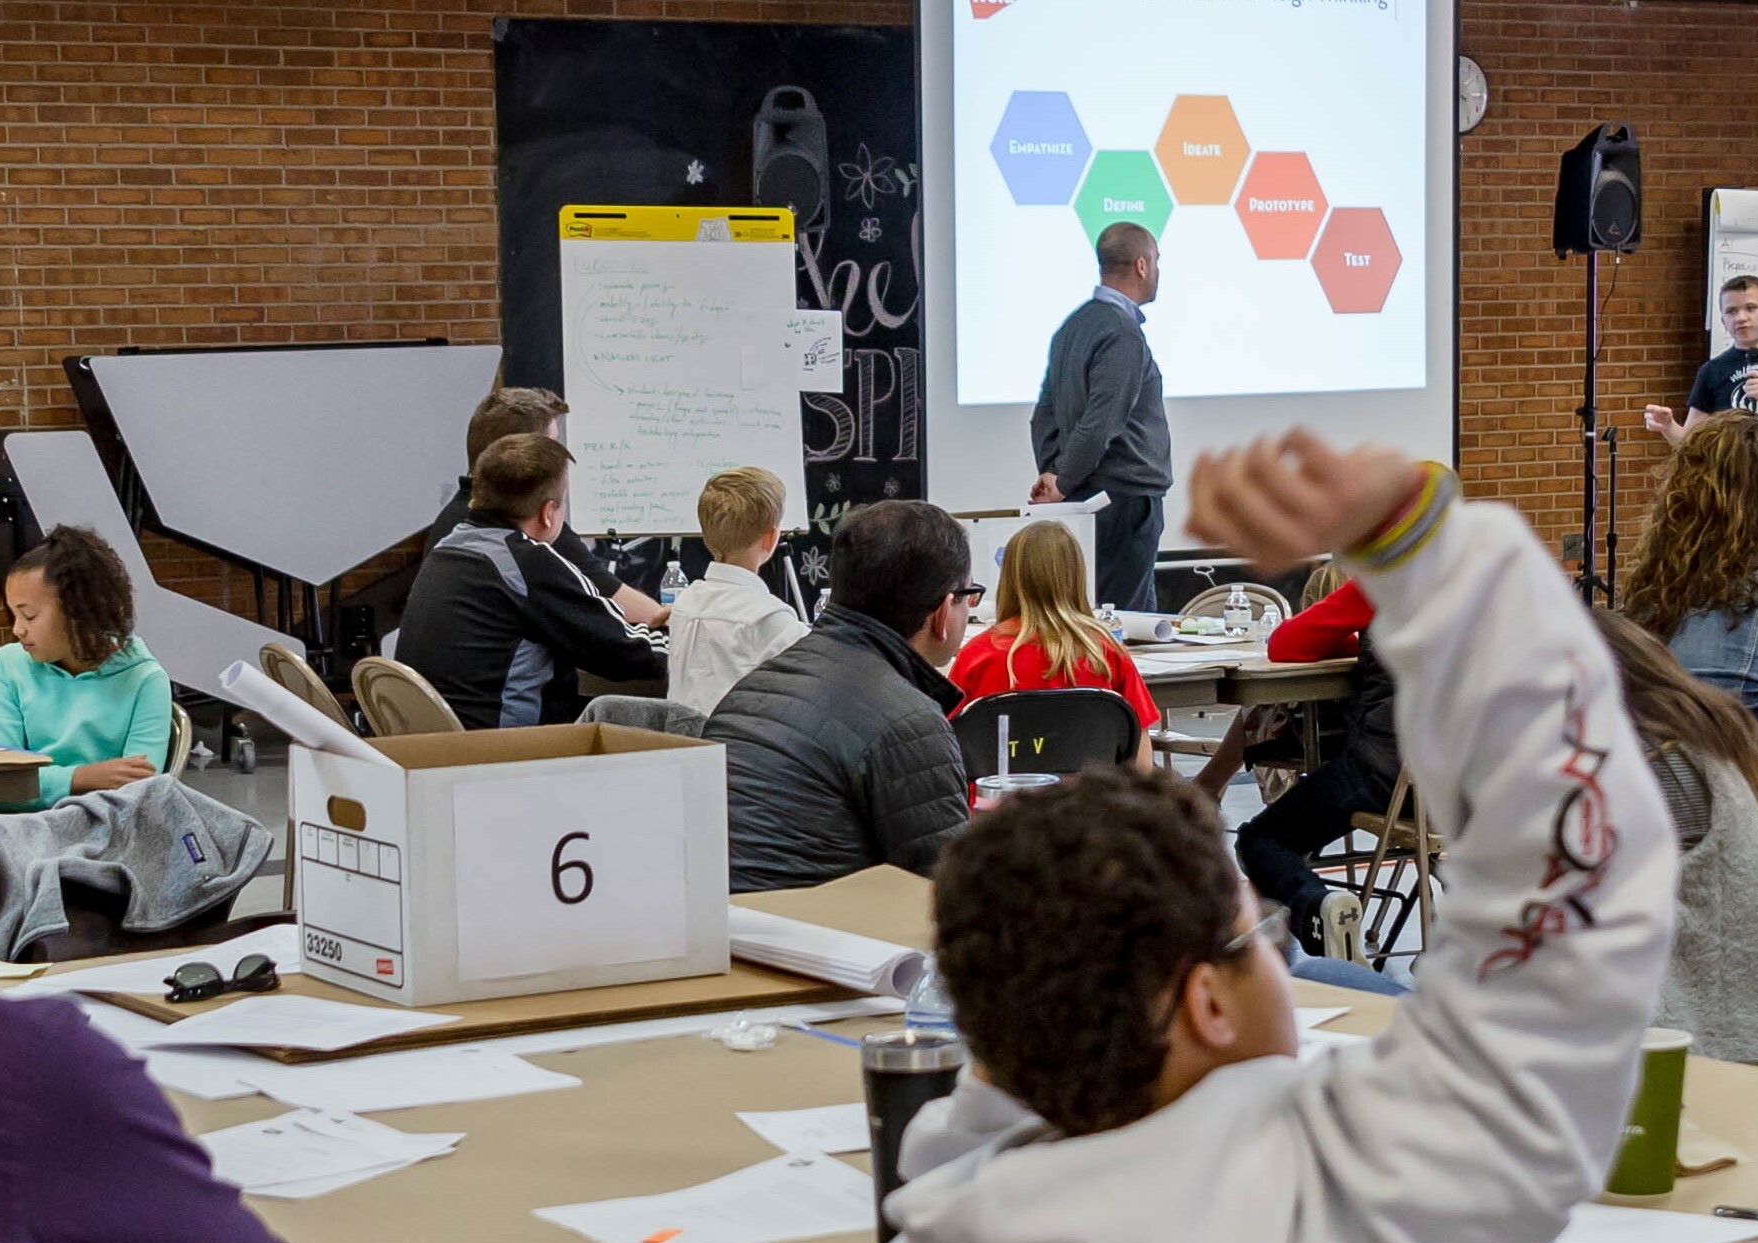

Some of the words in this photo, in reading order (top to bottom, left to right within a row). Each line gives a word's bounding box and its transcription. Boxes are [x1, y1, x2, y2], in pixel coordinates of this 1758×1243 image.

[1008, 140, 1074, 156] EMPATHIZE
[1183, 141, 1222, 157] IDEATE
[1103, 197, 1145, 213] DEFINE
[1249, 197, 1315, 213] PROTOTYPE
[1344, 252, 1371, 268] TEST
[1008, 740, 1020, 758] T
[1033, 737, 1044, 755] V
[551, 831, 595, 905] 6
[306, 933, 342, 963] 33250
